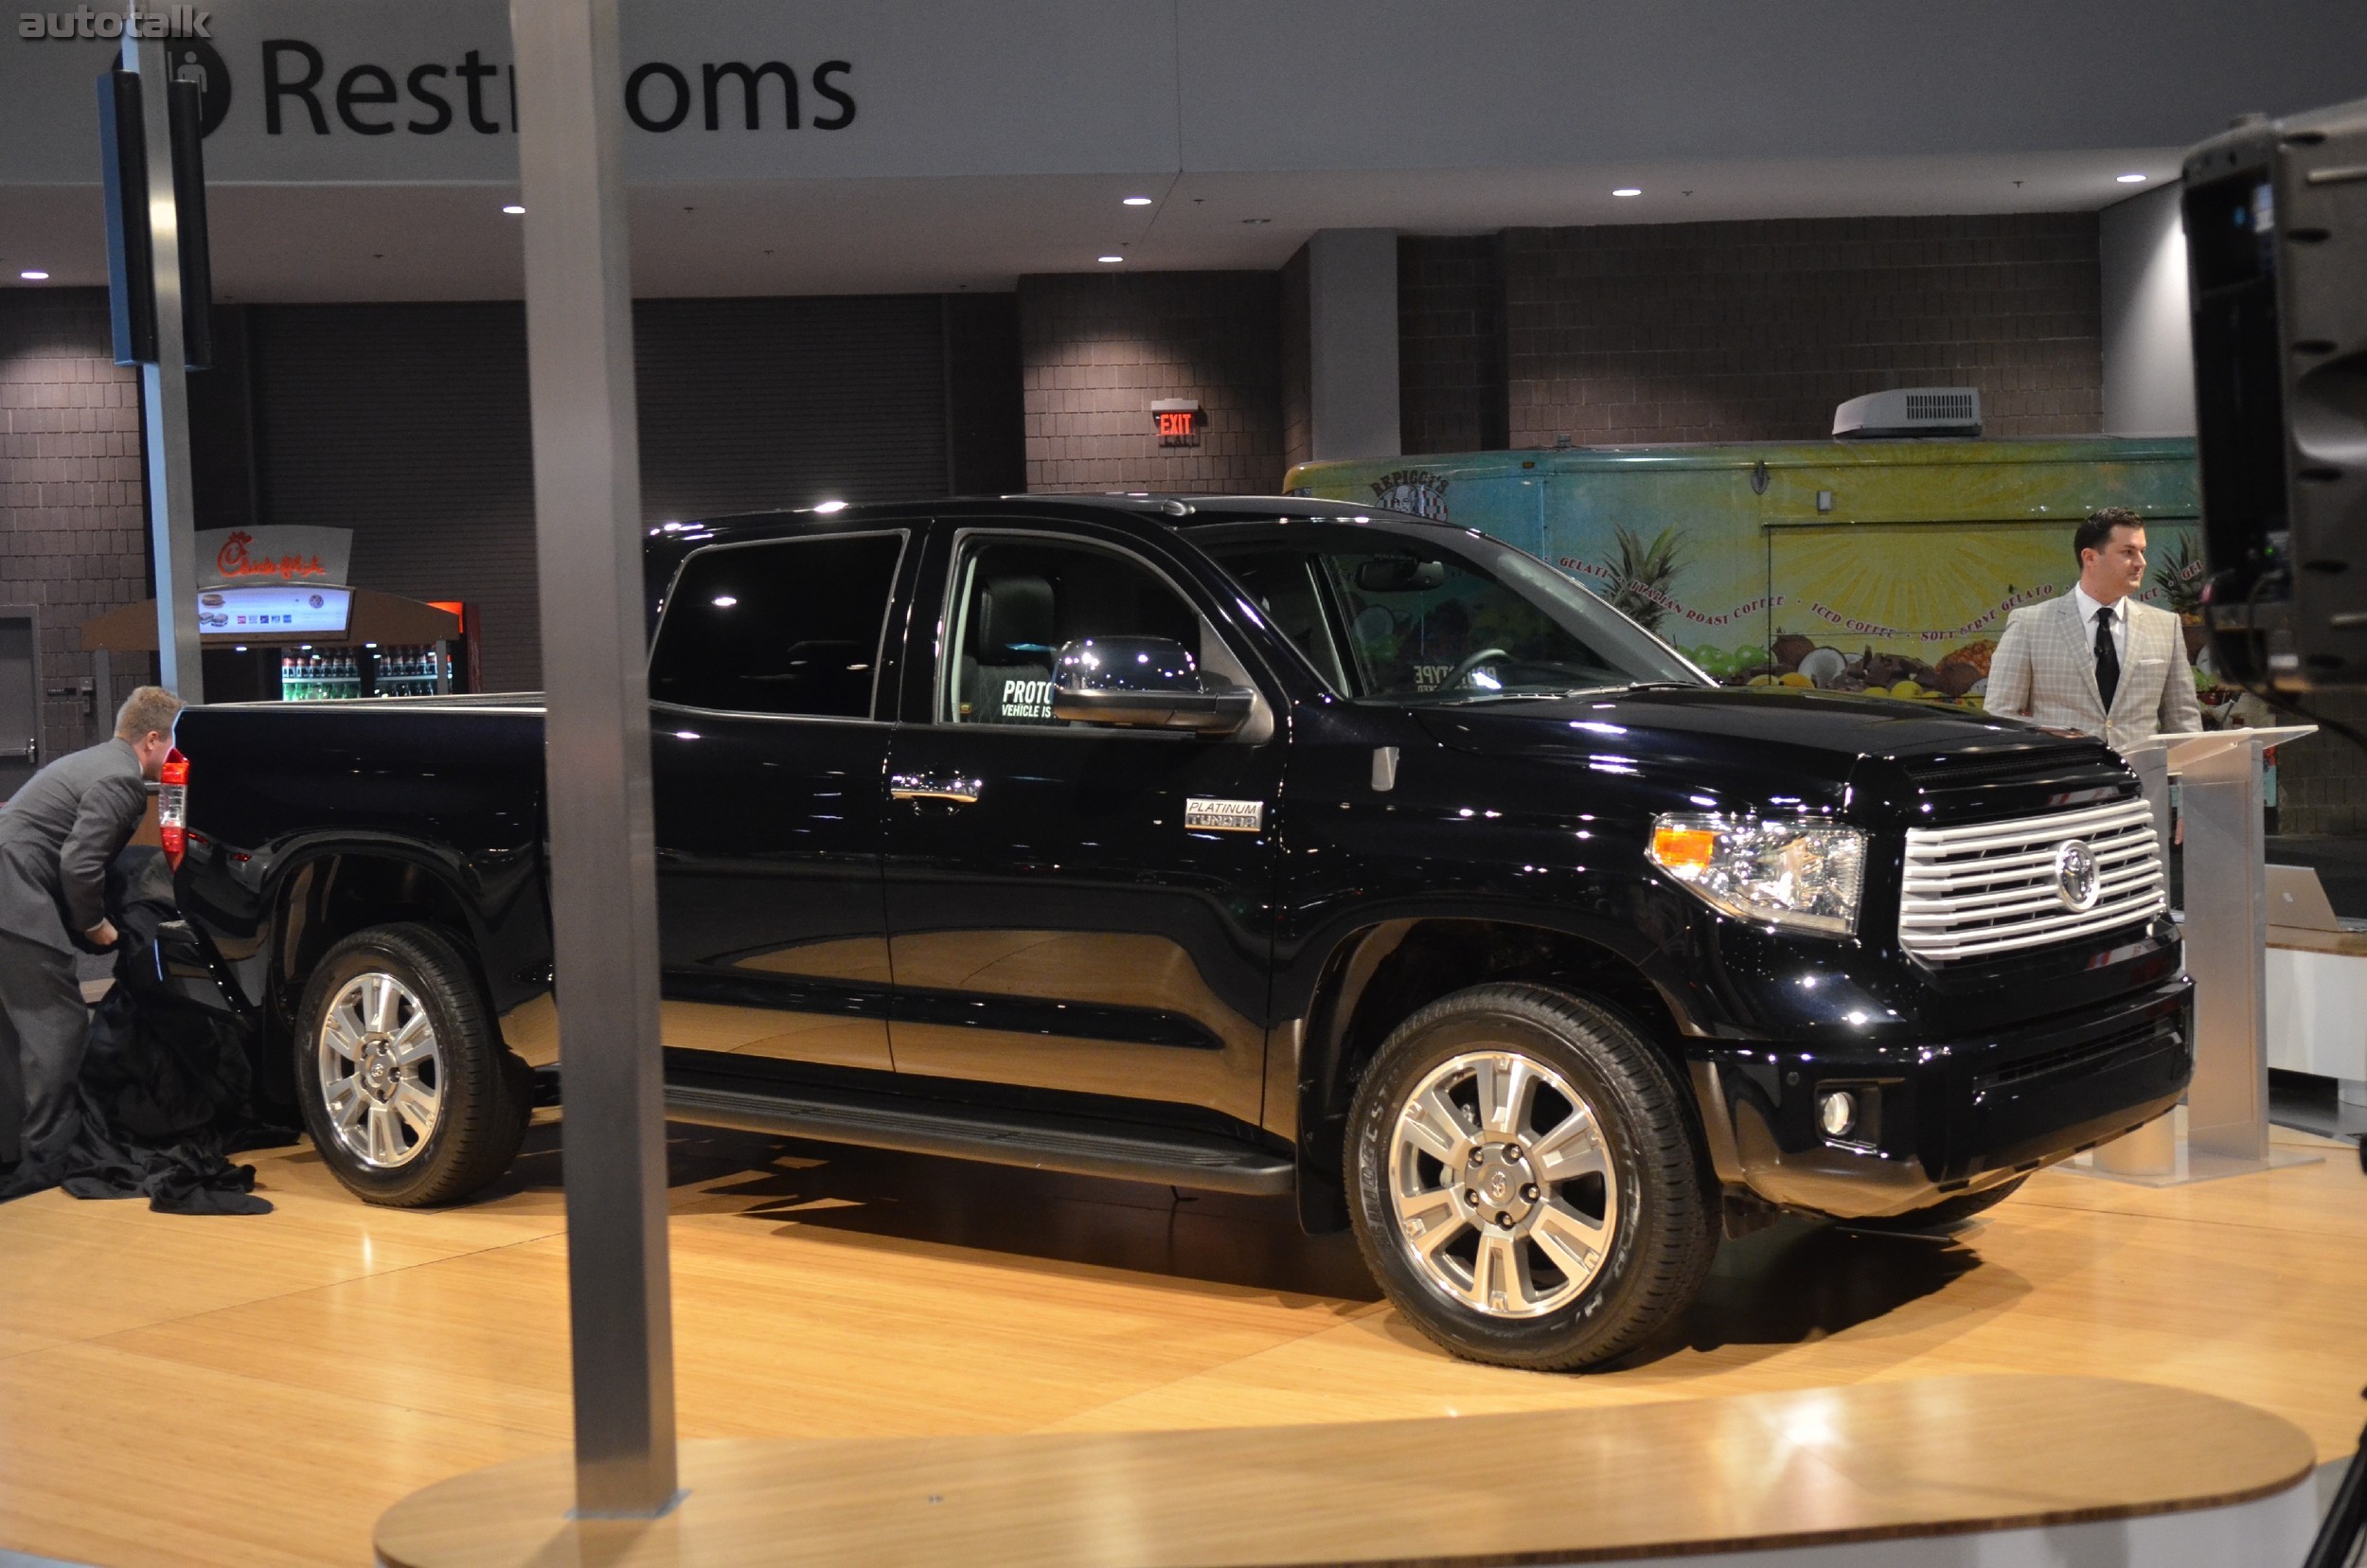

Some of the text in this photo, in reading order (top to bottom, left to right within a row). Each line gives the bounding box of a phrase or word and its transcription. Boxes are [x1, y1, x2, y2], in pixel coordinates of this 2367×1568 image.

[262, 40, 858, 136] Restoms
[1160, 413, 1192, 436] EXIT
[1559, 557, 1610, 579] GELATI
[1685, 609, 1730, 626] ROAST
[1733, 596, 1785, 619] COFFEE
[1811, 603, 1842, 623] ICED
[1845, 618, 1896, 639] COFFEE
[1920, 631, 1955, 642] SOFT
[2001, 584, 2054, 612] GELATO
[1002, 704, 1052, 718] VEHICLE IS
[1189, 802, 1257, 814] PLATINUM
[1188, 814, 1258, 827] TUNDRA
